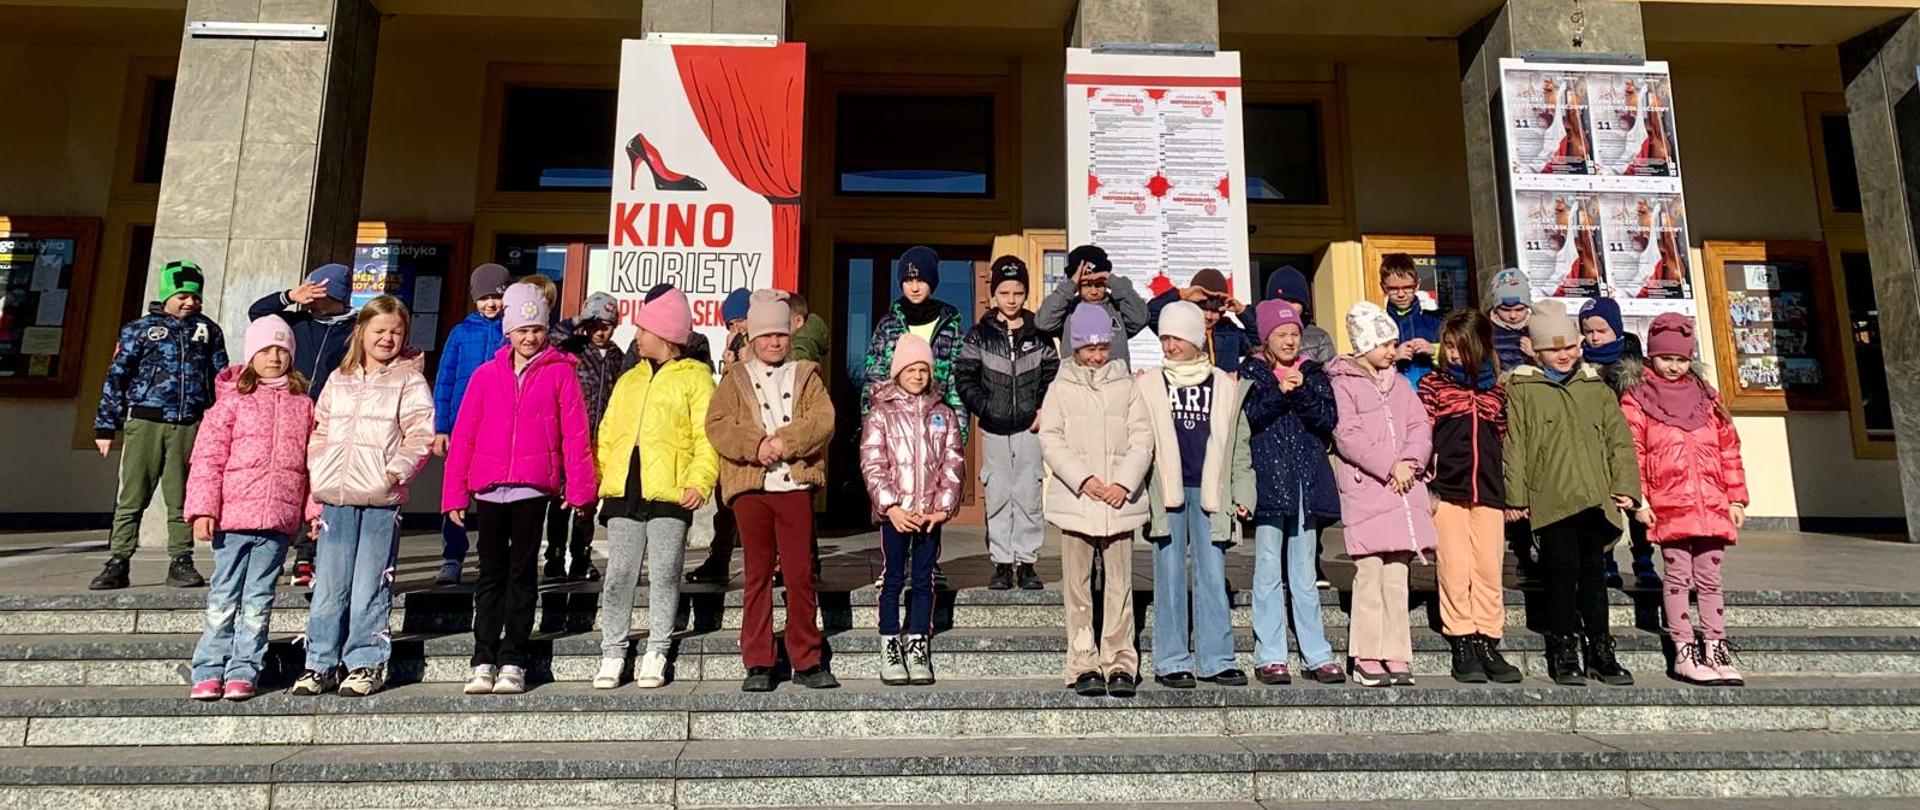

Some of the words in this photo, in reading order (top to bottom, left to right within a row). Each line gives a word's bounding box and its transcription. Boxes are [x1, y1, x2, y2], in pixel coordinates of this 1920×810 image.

[1515, 119, 1529, 128] 11
[1598, 121, 1611, 130] 11
[613, 203, 734, 248] KINO
[1527, 241, 1541, 250] 11
[1610, 243, 1624, 251] 11
[371, 246, 437, 259] galaktyka
[611, 251, 761, 294] KOBIETY
[192, 322, 209, 344] A
[1168, 385, 1211, 413] ARI
